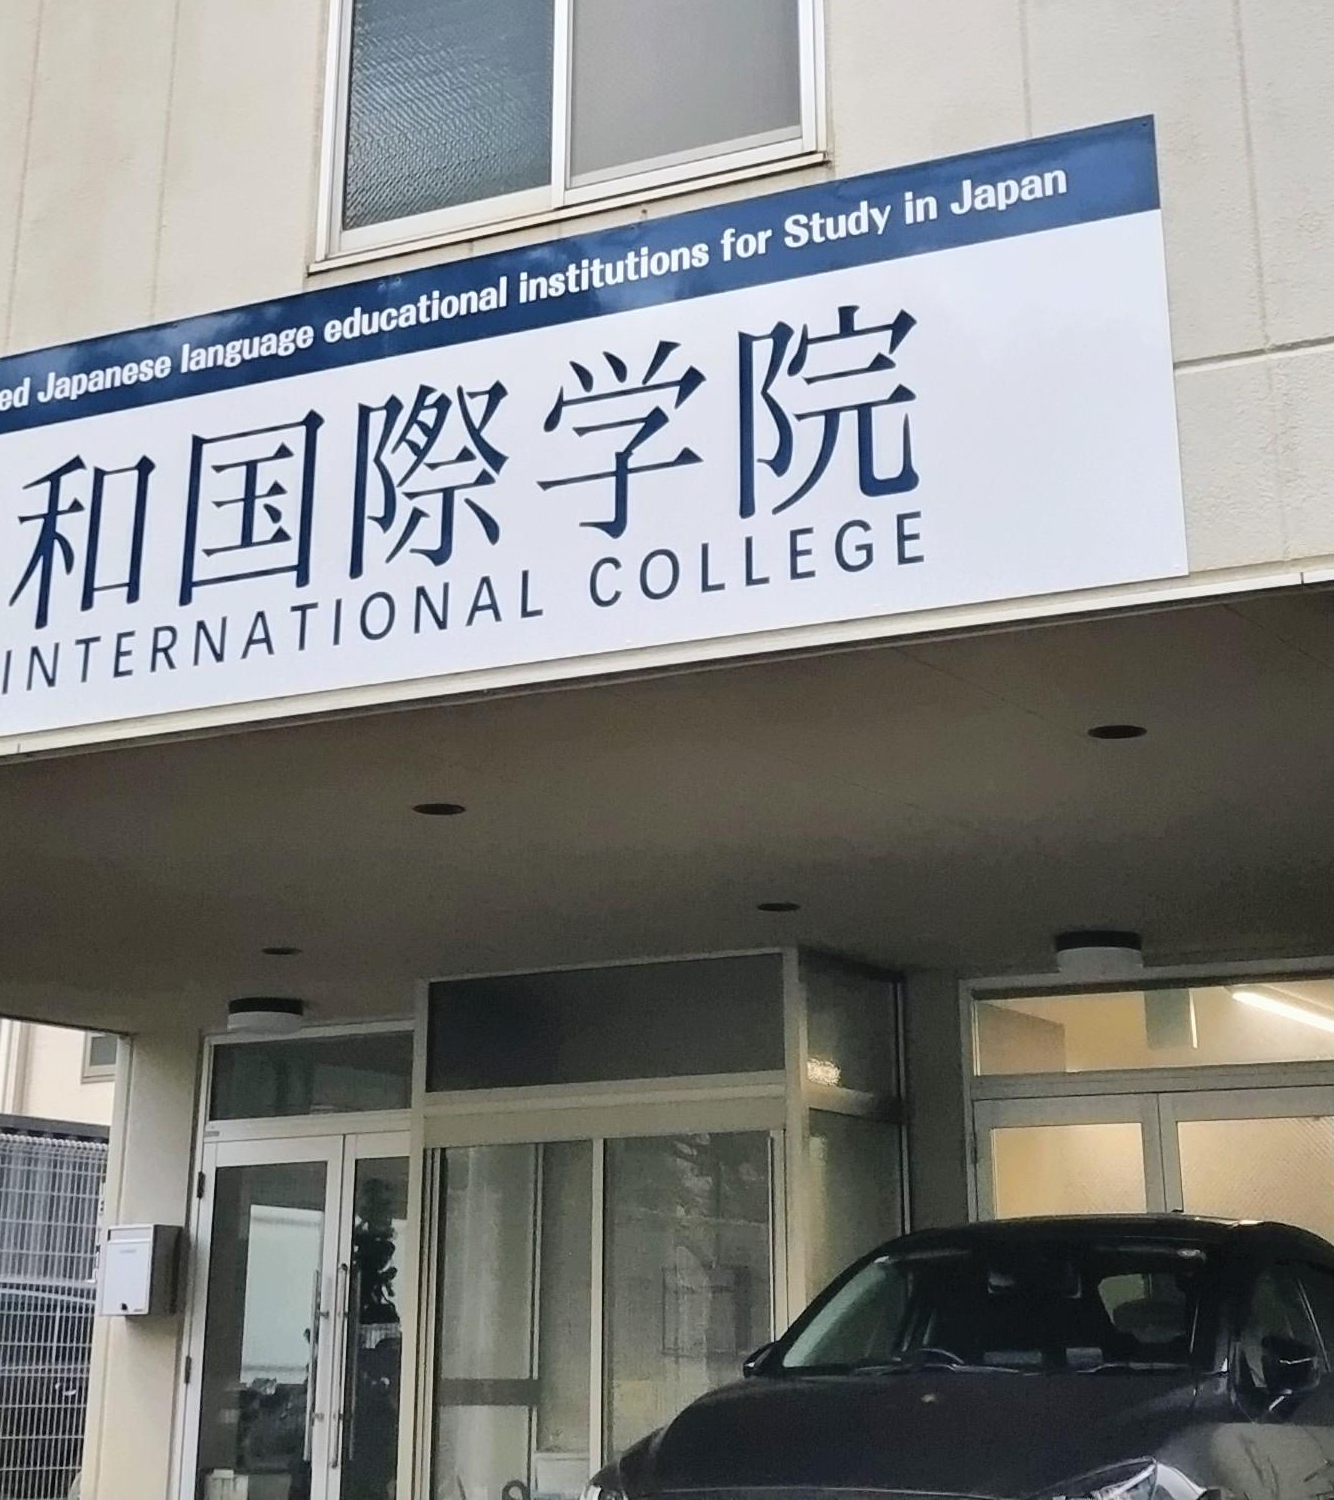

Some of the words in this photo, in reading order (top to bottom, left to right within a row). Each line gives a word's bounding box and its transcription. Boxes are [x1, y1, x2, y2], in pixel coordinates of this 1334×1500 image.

[38, 356, 171, 403] Japanese
[181, 326, 314, 373] language
[325, 277, 507, 342] educational
[520, 244, 710, 303] institutions
[721, 228, 772, 262] for
[785, 201, 892, 248] Study
[905, 192, 937, 224] in
[951, 170, 1067, 215] Japan
[3, 570, 543, 694] INTERNATIONAL
[590, 512, 924, 607] COLLEGE
